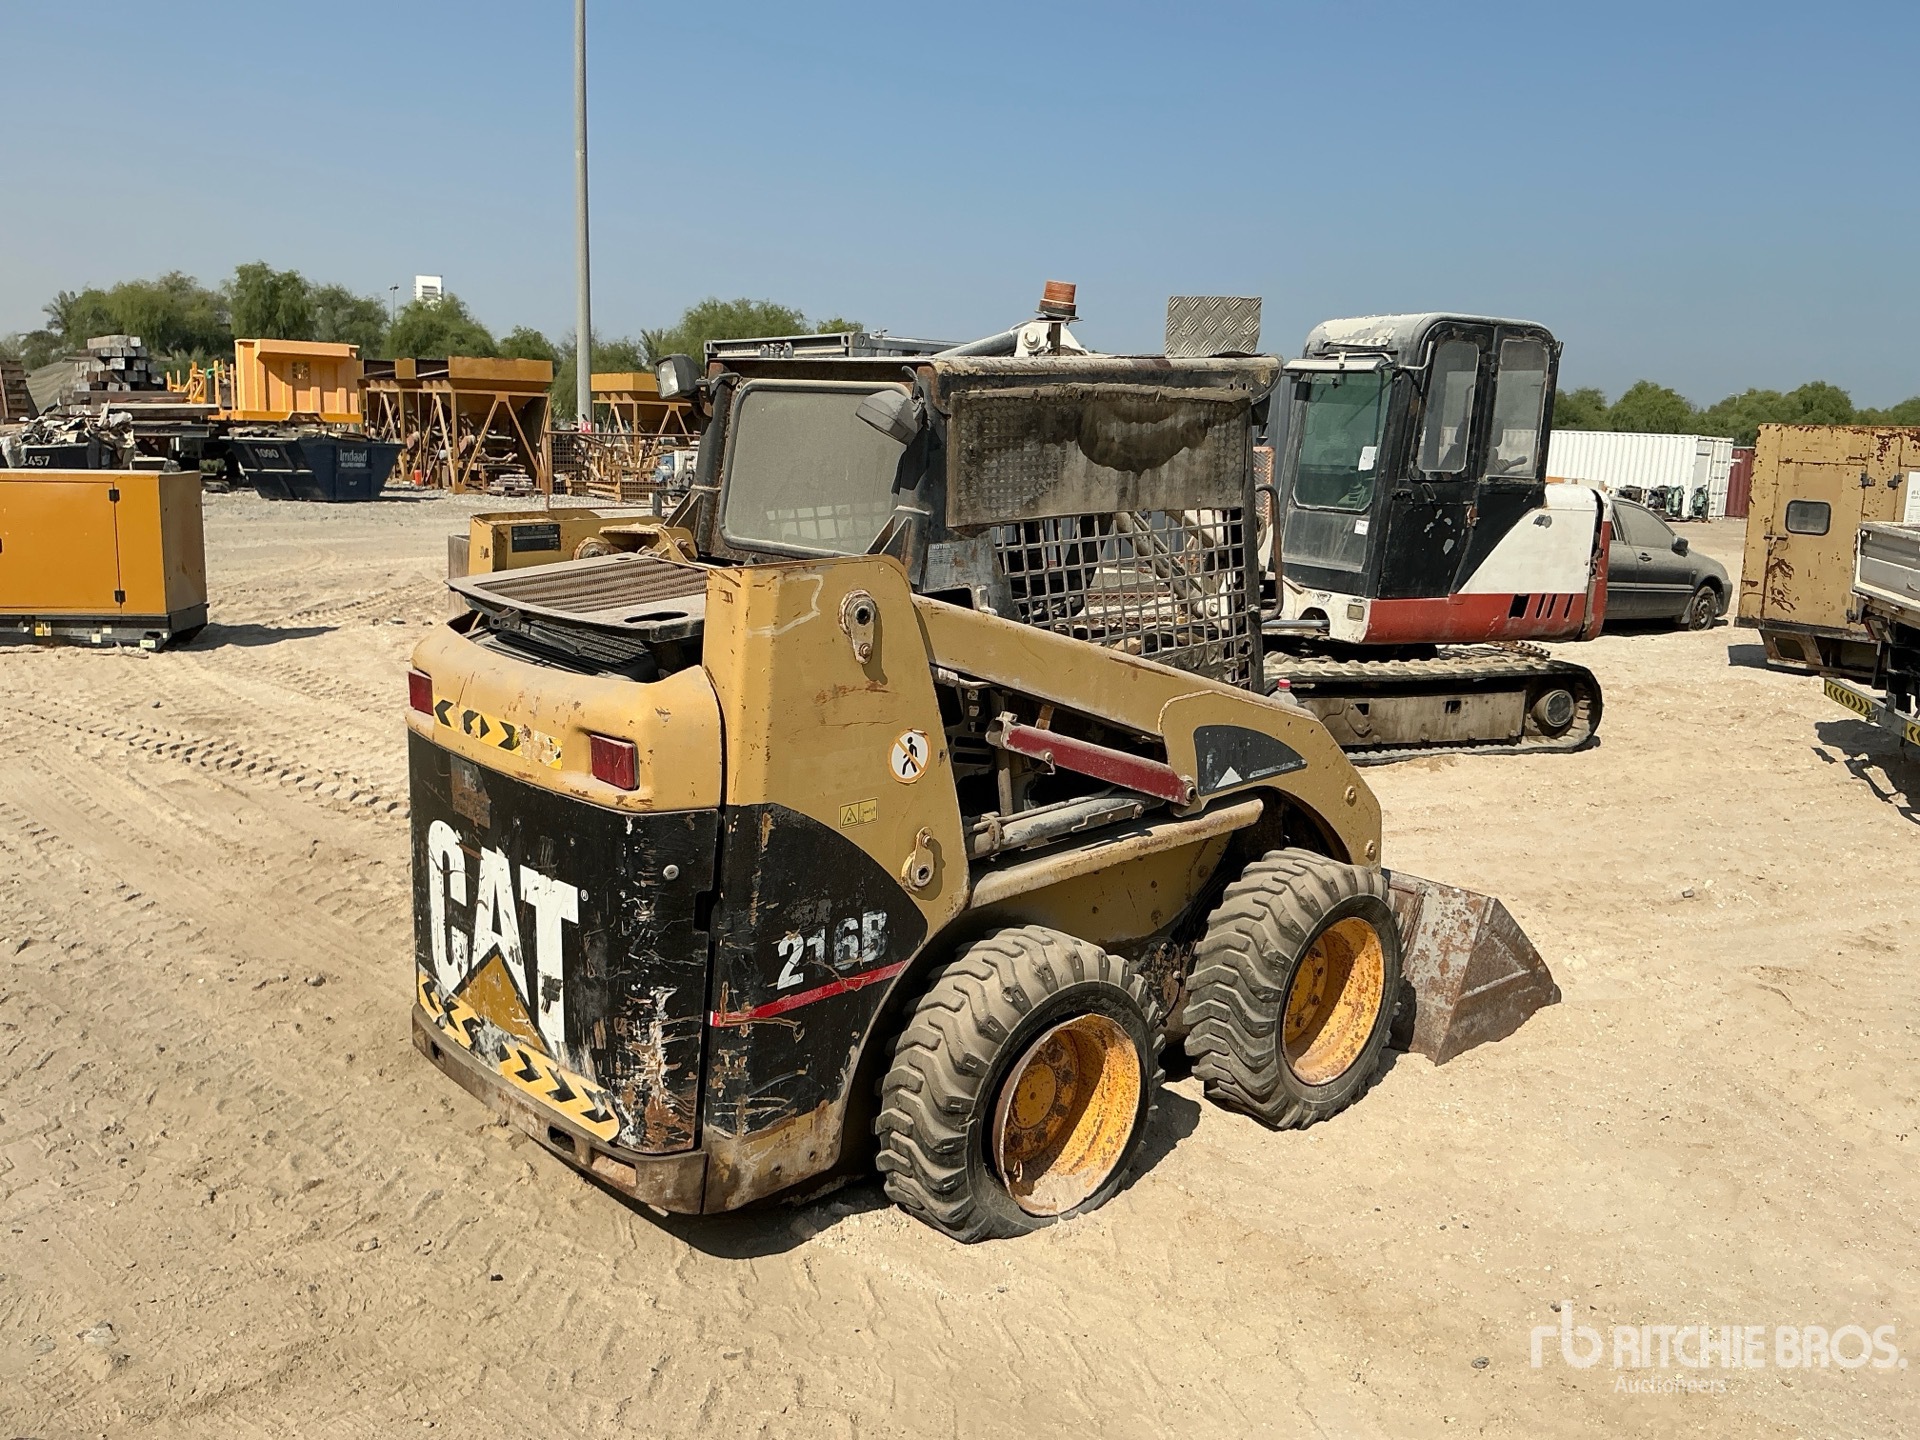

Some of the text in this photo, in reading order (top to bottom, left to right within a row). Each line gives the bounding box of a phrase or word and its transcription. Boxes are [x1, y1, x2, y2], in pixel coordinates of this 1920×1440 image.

[23, 456, 50, 466] 457
[428, 819, 580, 1058] CAT
[777, 909, 889, 991] 216B
